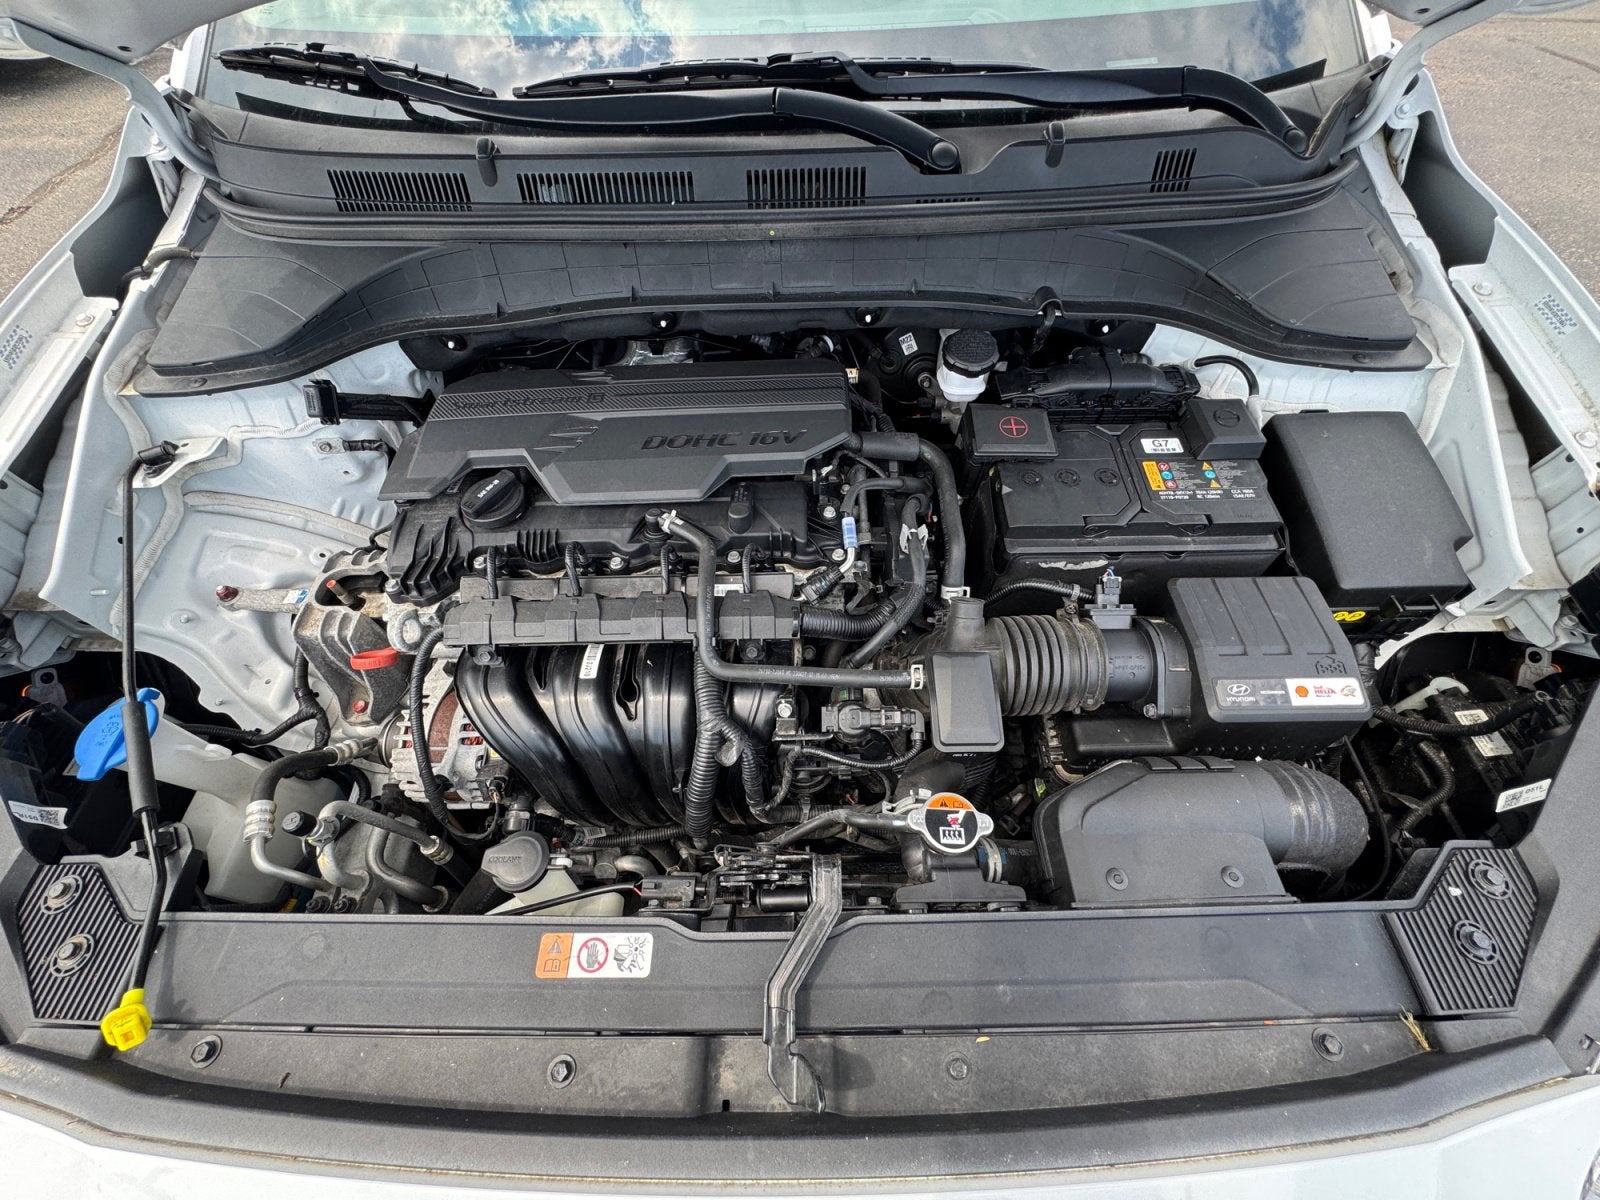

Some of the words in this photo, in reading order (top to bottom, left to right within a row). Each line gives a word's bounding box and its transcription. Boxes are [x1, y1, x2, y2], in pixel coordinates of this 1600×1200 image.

[641, 432, 742, 450] DOHC
[749, 429, 808, 446] 16V
[488, 855, 522, 863] COOLANT
